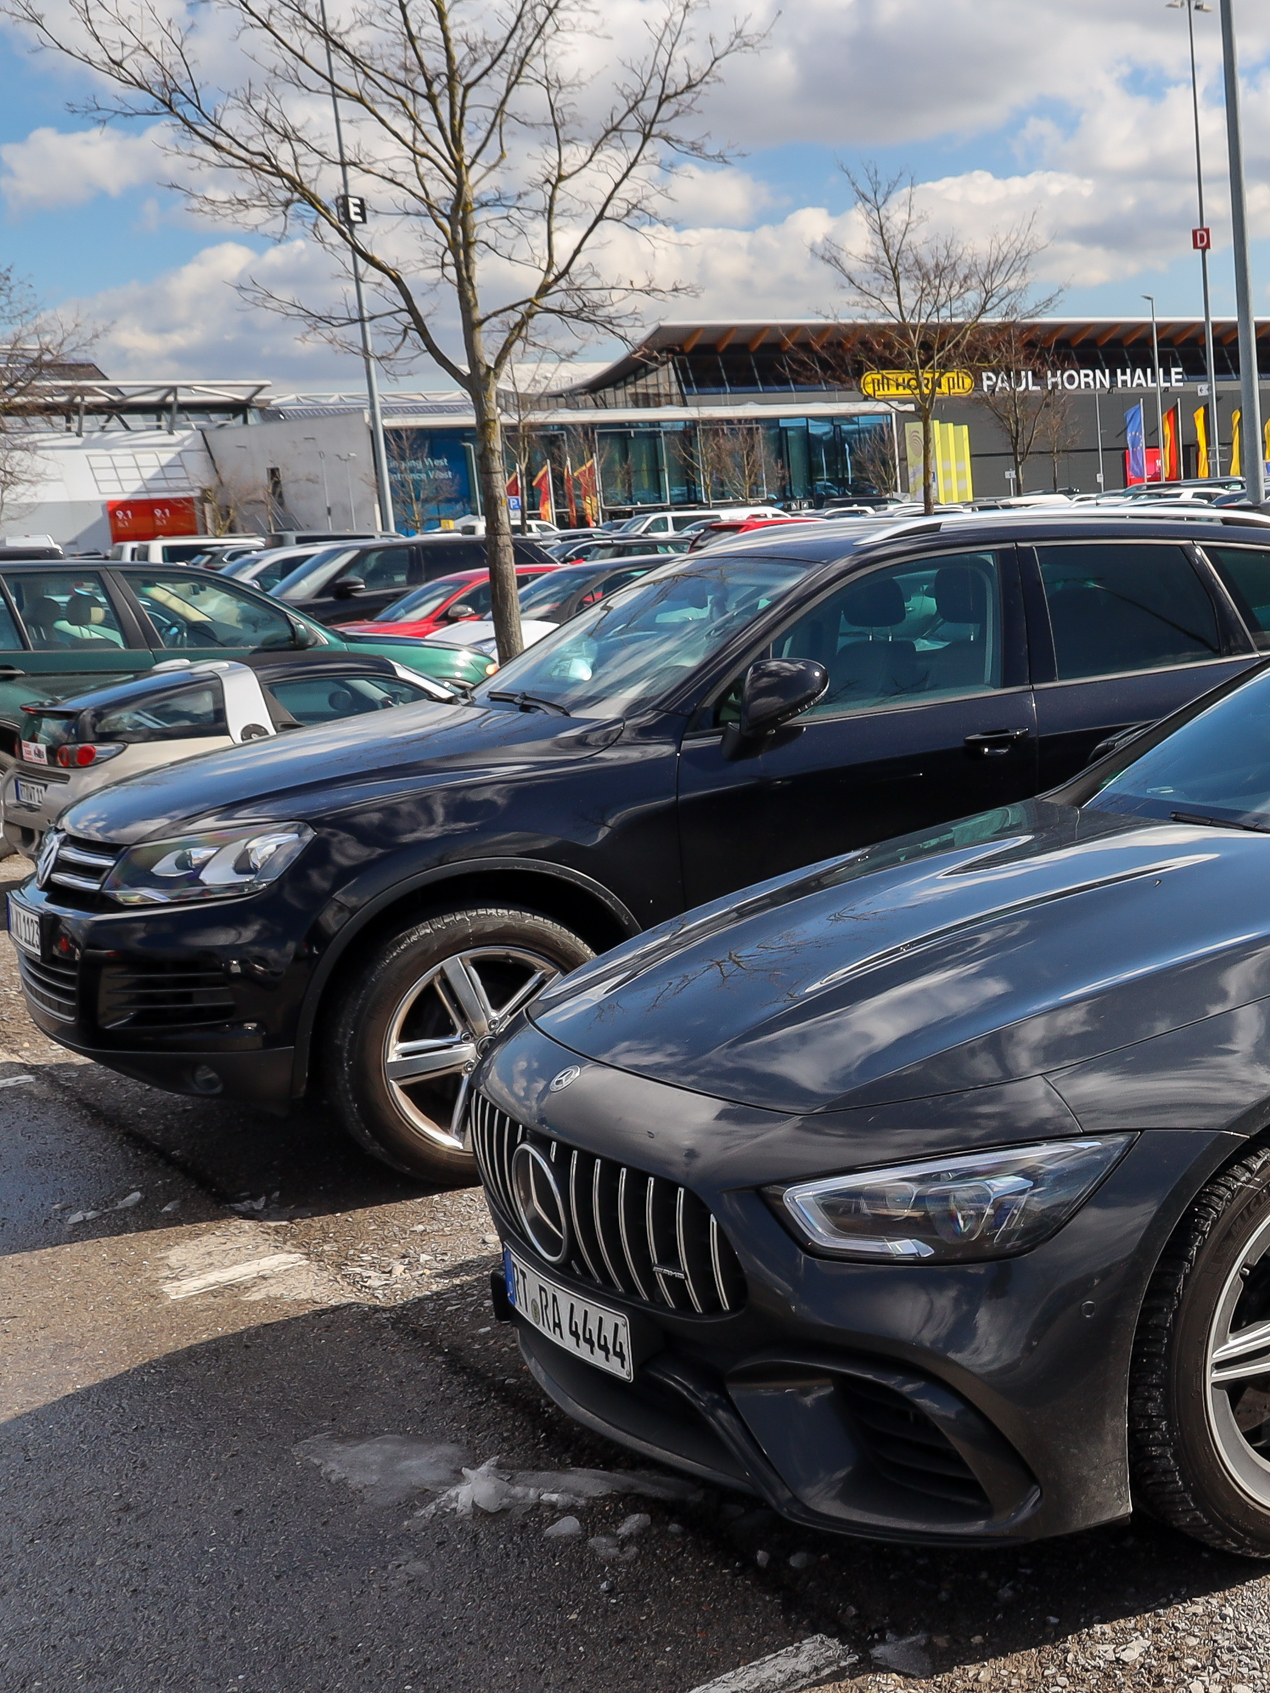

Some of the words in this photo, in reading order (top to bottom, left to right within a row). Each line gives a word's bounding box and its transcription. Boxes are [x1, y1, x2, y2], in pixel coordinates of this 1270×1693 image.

[348, 197, 363, 222] E
[1197, 231, 1207, 247] D
[982, 370, 1041, 392] PAUL
[1047, 368, 1110, 391] HORN
[1116, 367, 1184, 388] HALLE
[512, 1263, 529, 1313] RT
[539, 1284, 564, 1341] RA
[568, 1302, 626, 1369] 4444
